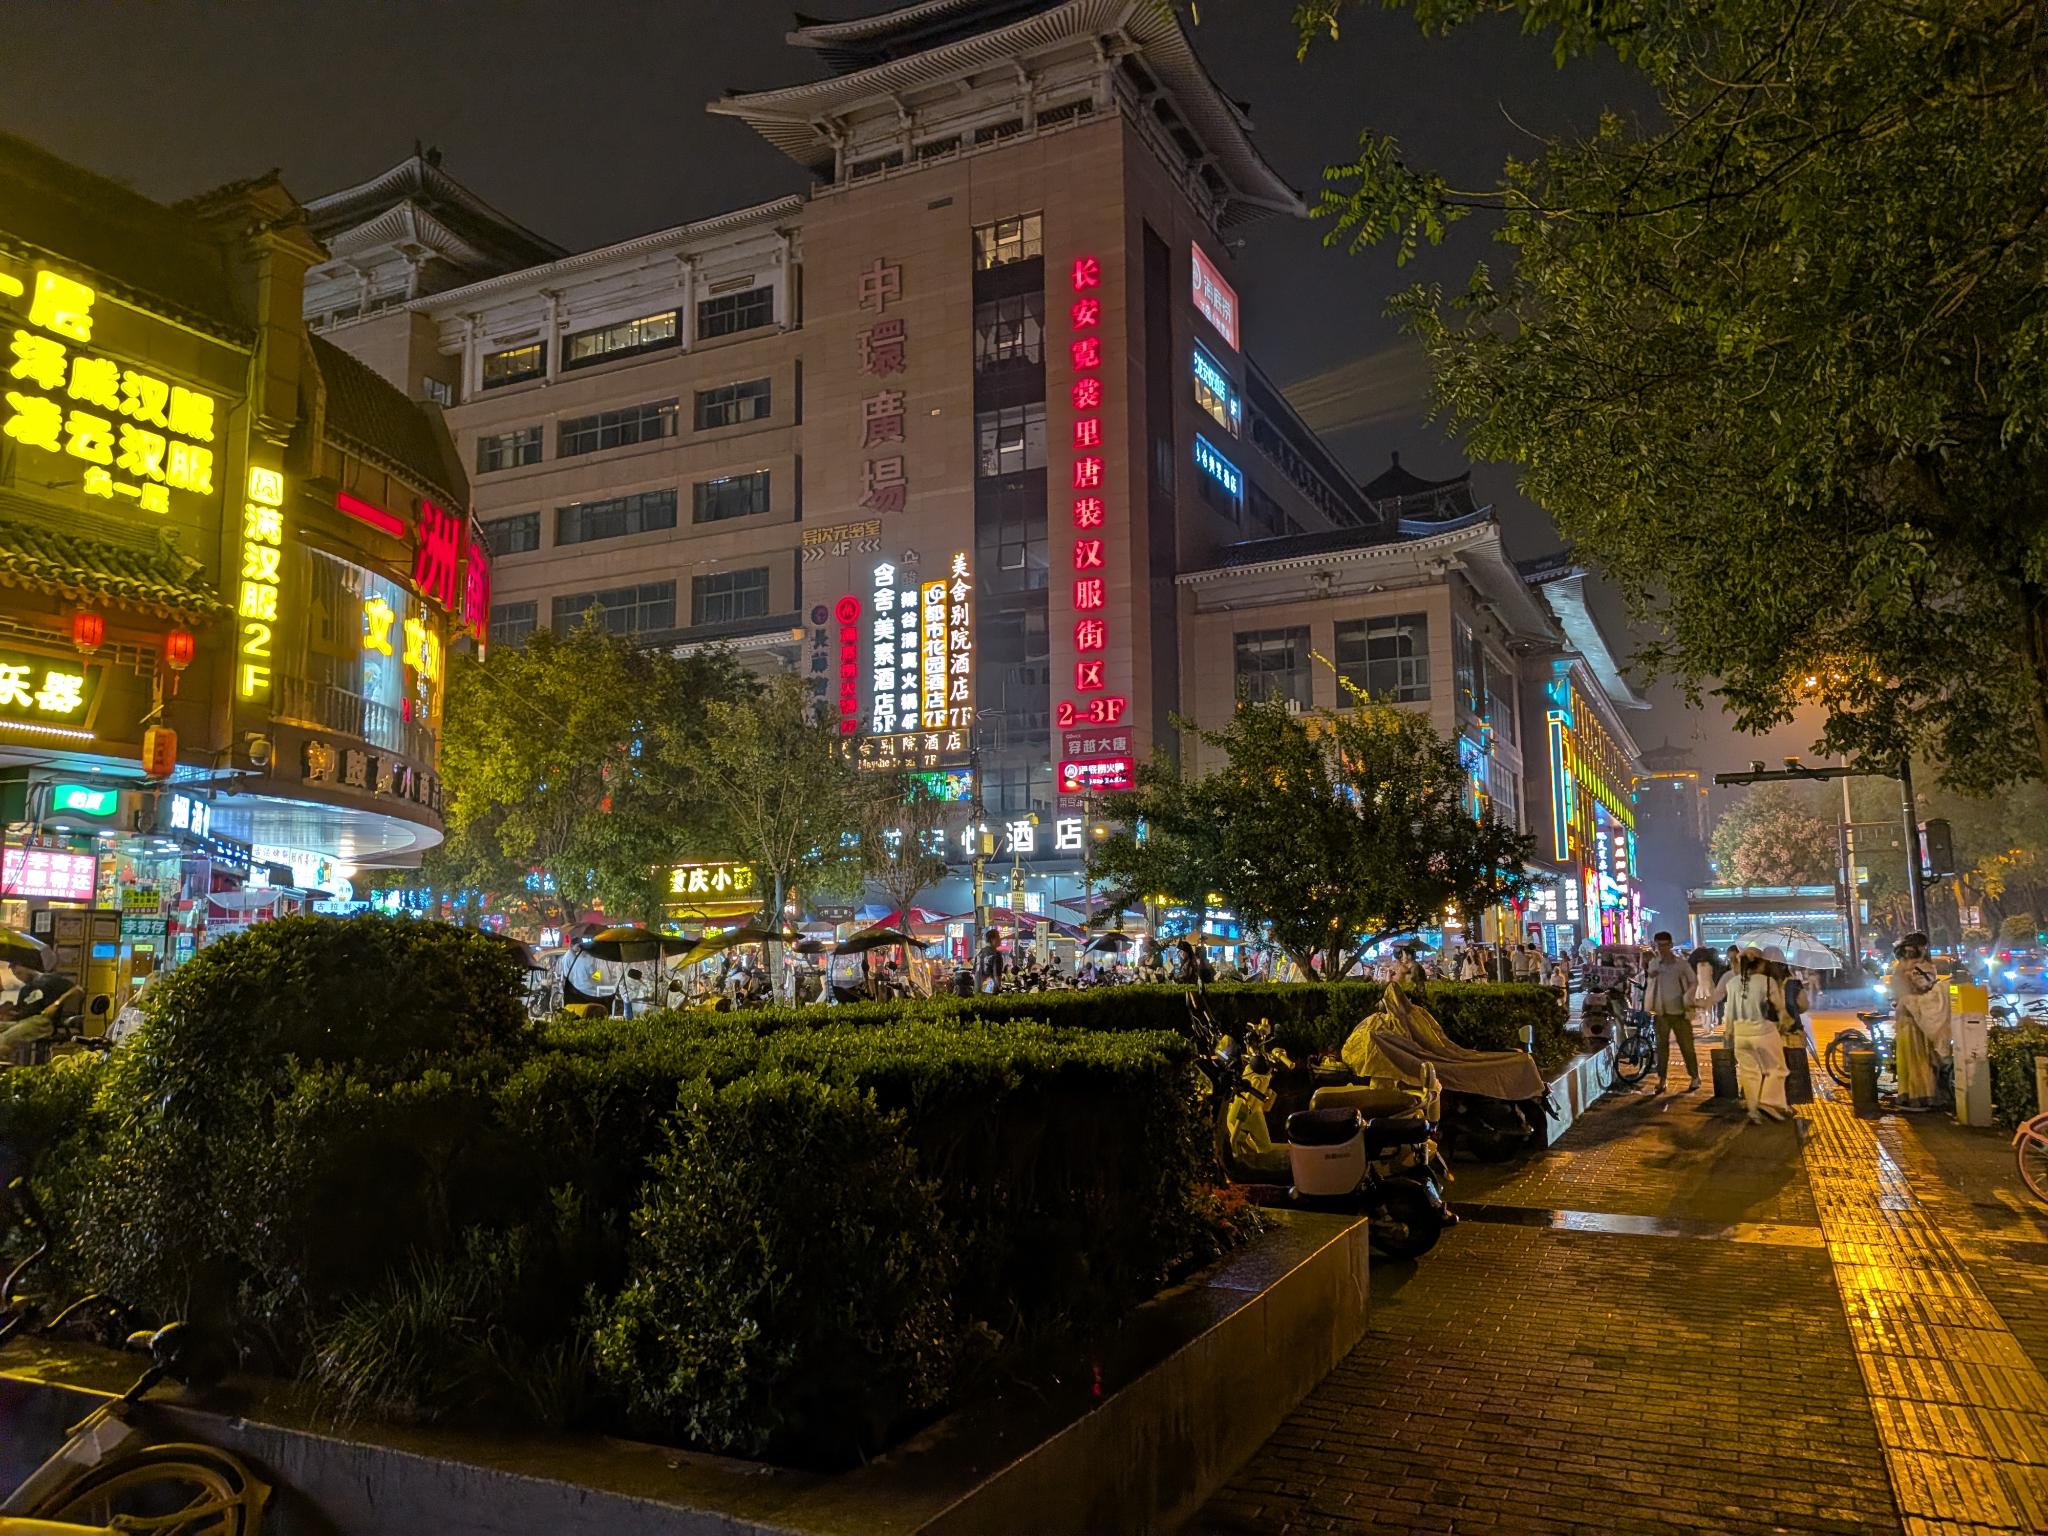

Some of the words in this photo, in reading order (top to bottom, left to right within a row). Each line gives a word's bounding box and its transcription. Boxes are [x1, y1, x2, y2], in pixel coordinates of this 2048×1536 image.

[857, 256, 906, 513] 中環廣場
[1071, 258, 1104, 690] 长安霓裳里唐装汉服街区
[802, 519, 881, 546] 异次元密室
[831, 541, 851, 557] 4F
[1058, 697, 1125, 726] 2-3F
[1068, 736, 1127, 755] 穿越大唐
